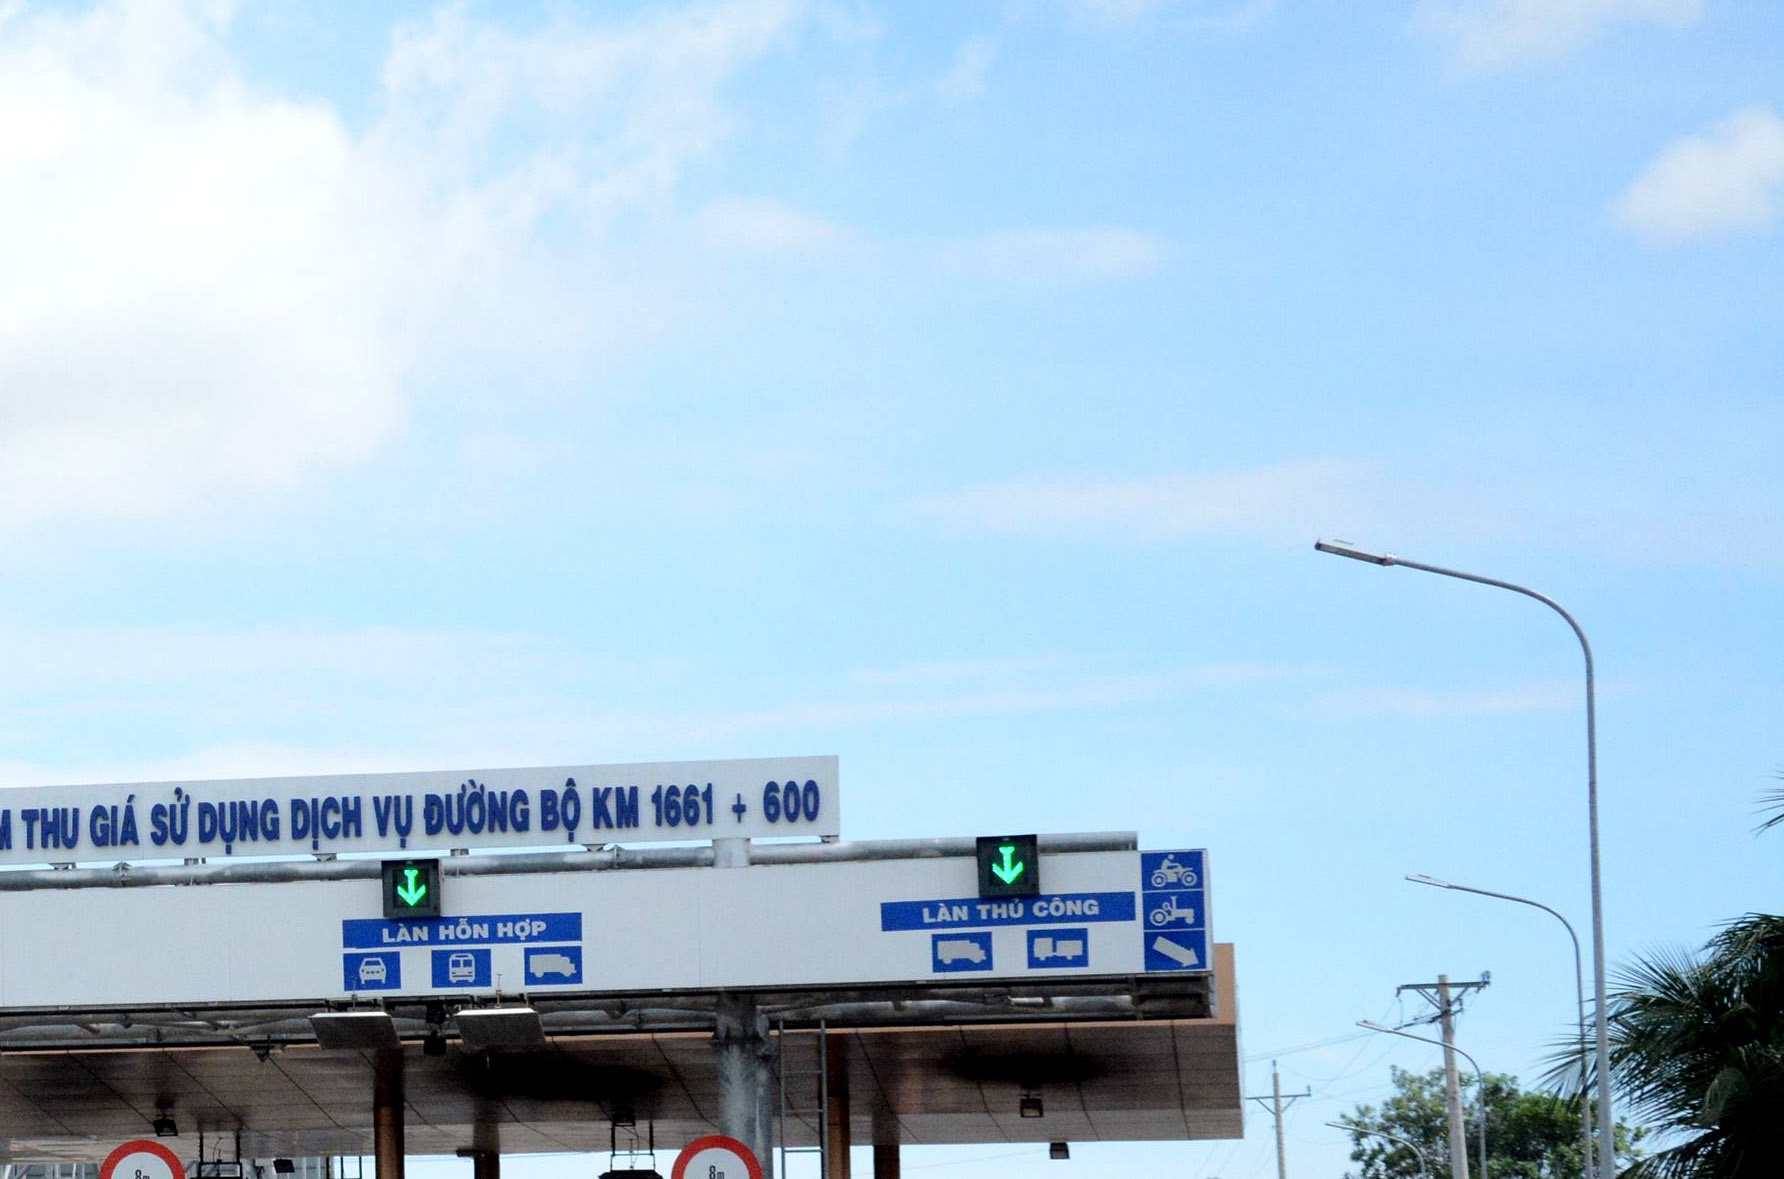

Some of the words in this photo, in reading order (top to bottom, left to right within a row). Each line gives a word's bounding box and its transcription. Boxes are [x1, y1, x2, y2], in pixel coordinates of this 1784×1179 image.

[21, 808, 80, 849] THU
[89, 794, 140, 847] GIÁ
[150, 786, 191, 846] SỬ
[198, 797, 281, 856] DỤNG
[290, 796, 363, 850] DỊCH
[372, 795, 414, 848] VỤ
[423, 779, 530, 835] ĐƯỜNG
[540, 778, 582, 842] BỘ
[592, 786, 640, 829] KM
[651, 783, 714, 827] 1661
[732, 793, 748, 824] +
[762, 780, 821, 822] 600
[922, 902, 969, 923] LÀN
[975, 898, 1025, 920] THỦ
[1032, 897, 1100, 917] CÔNG
[382, 922, 429, 943] LÀN
[438, 918, 489, 940] HỖN
[496, 919, 547, 941] HỢP
